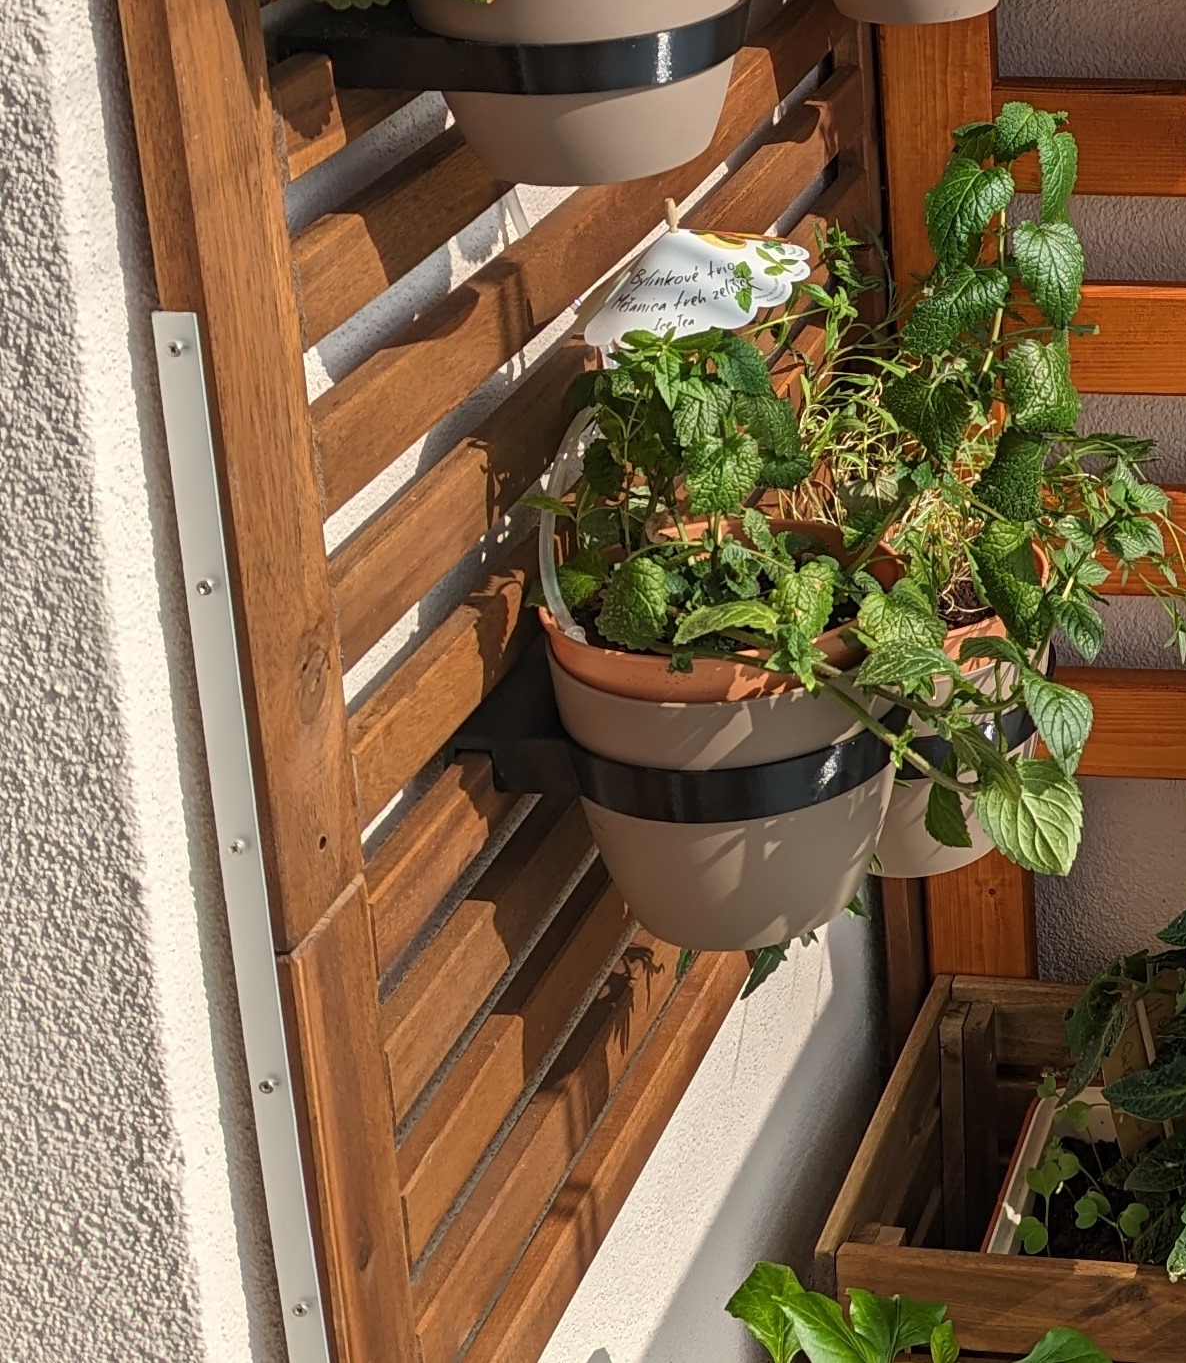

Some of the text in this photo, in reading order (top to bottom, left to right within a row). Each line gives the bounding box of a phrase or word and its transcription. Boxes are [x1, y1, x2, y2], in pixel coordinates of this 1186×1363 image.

[629, 259, 735, 292] Bylinkové trio
[673, 288, 707, 310] treh
[652, 313, 695, 331] Ice Tea
